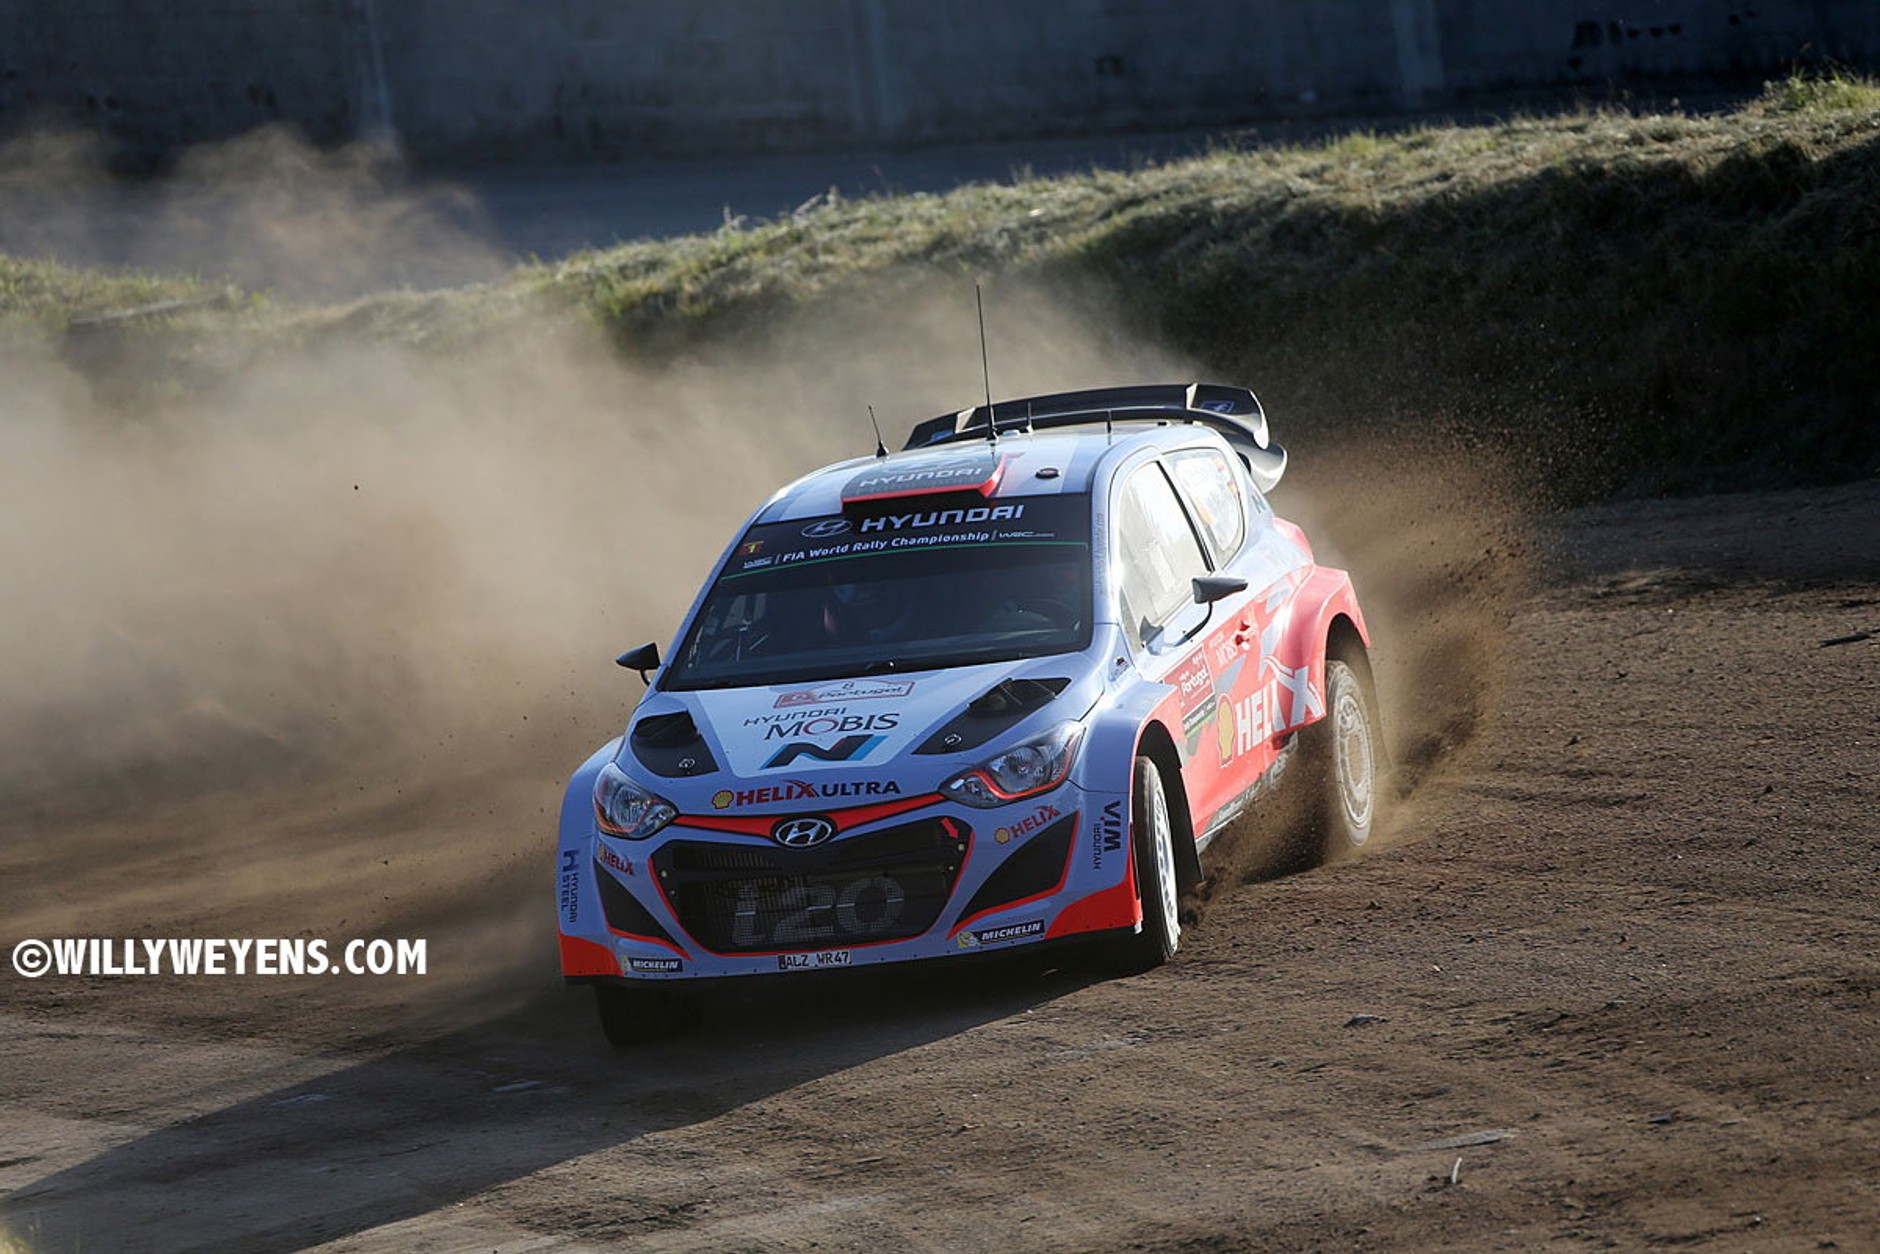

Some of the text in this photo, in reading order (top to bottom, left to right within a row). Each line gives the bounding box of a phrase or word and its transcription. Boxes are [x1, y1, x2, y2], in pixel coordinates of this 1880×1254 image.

[860, 468, 981, 487] HYUNDAI
[860, 504, 1024, 533] HYUNDAI
[783, 551, 804, 562] FIA
[809, 543, 849, 557] World
[852, 539, 887, 551] Rally
[891, 531, 989, 547] Championship
[743, 707, 847, 727] HYUNDAI
[1235, 654, 1326, 756] HELIX
[764, 713, 900, 740] MOBIS
[736, 779, 901, 806] HELIX ULTRA
[1009, 804, 1061, 838] HELIX
[1092, 822, 1102, 870] HYUNDAI
[603, 851, 634, 876] HELIX
[561, 874, 570, 911] STEEL
[569, 872, 579, 923] HYUNDAI
[981, 923, 1041, 941] MICHELIN
[633, 960, 679, 969] MICHELIN
